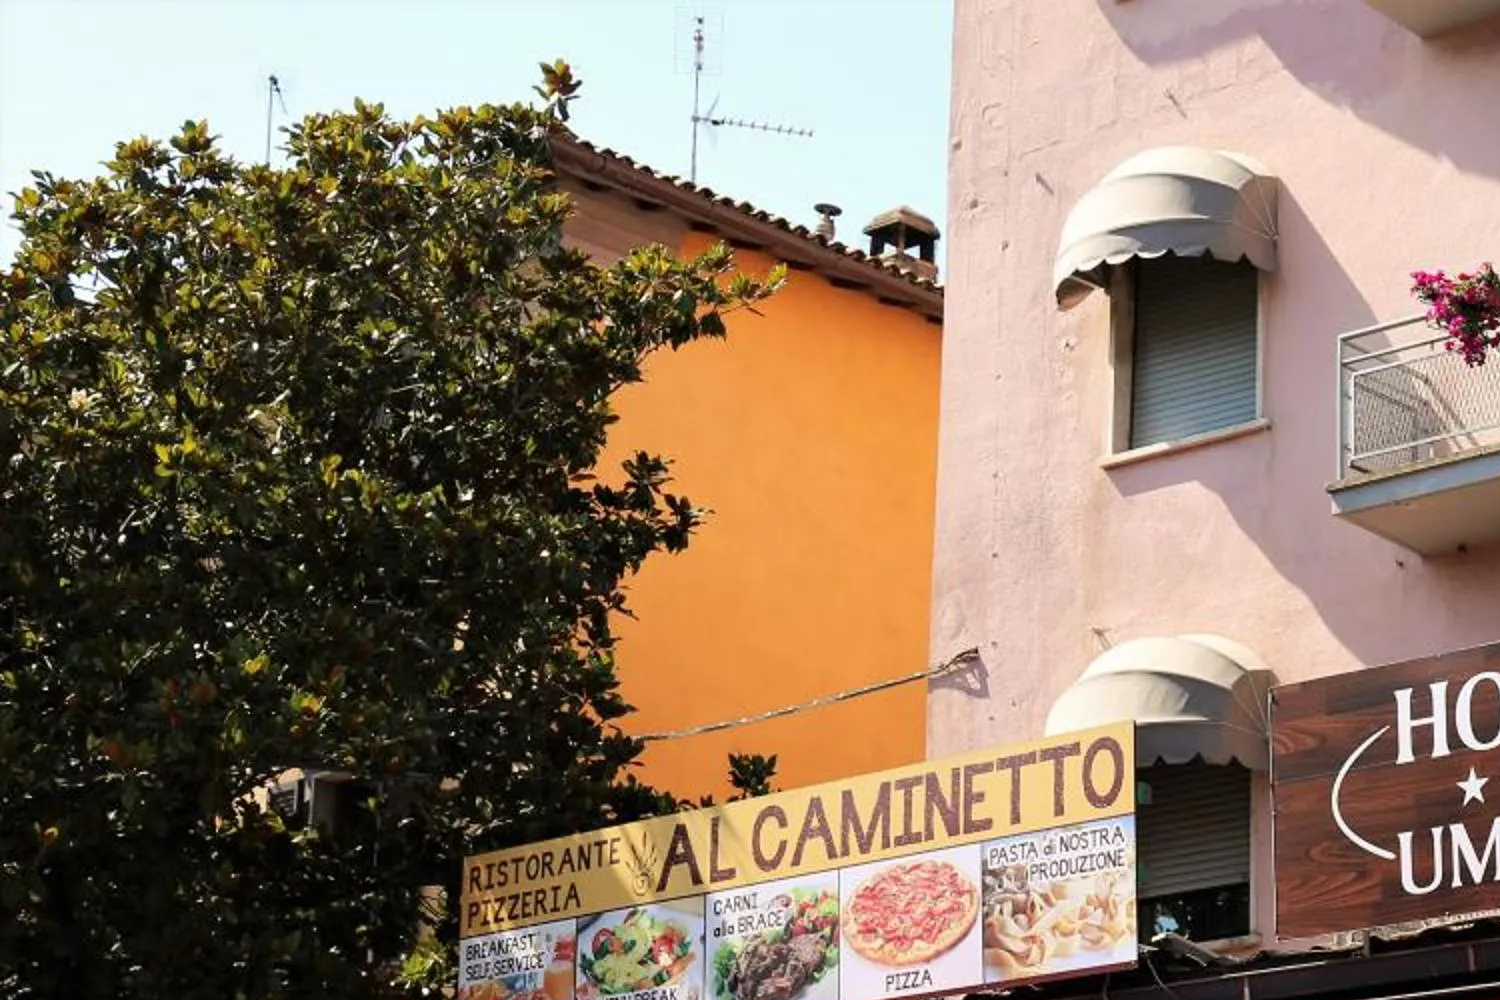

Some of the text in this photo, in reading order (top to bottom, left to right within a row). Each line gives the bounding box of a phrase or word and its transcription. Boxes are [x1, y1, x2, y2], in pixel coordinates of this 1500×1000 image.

[656, 736, 1125, 894] AL CAMINETTO
[989, 825, 1125, 866] PASTA di NOSTRA
[468, 838, 621, 894] RISTORANTE
[1029, 849, 1125, 881] PRODUZIONE
[467, 883, 581, 928] PIZZERIA
[713, 892, 759, 915] CARNI
[738, 909, 785, 933] BRACE
[466, 933, 537, 961] BREAKFAST
[465, 951, 545, 981] SELF SERVICE
[885, 969, 933, 992] PIZZA
